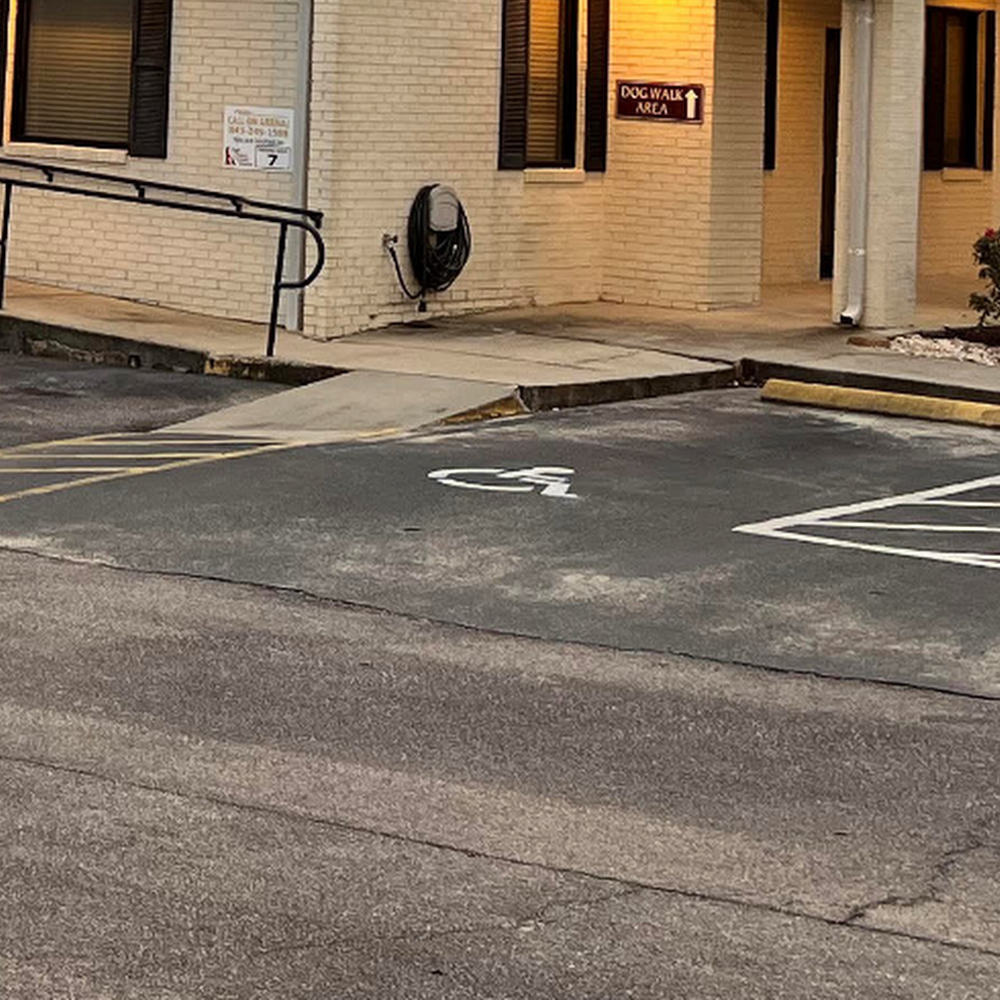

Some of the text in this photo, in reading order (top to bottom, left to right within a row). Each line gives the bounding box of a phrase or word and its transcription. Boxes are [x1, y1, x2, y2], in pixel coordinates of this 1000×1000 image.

[621, 85, 684, 101] DOG WALK
[636, 101, 668, 115] AREA
[267, 154, 278, 166] 7
